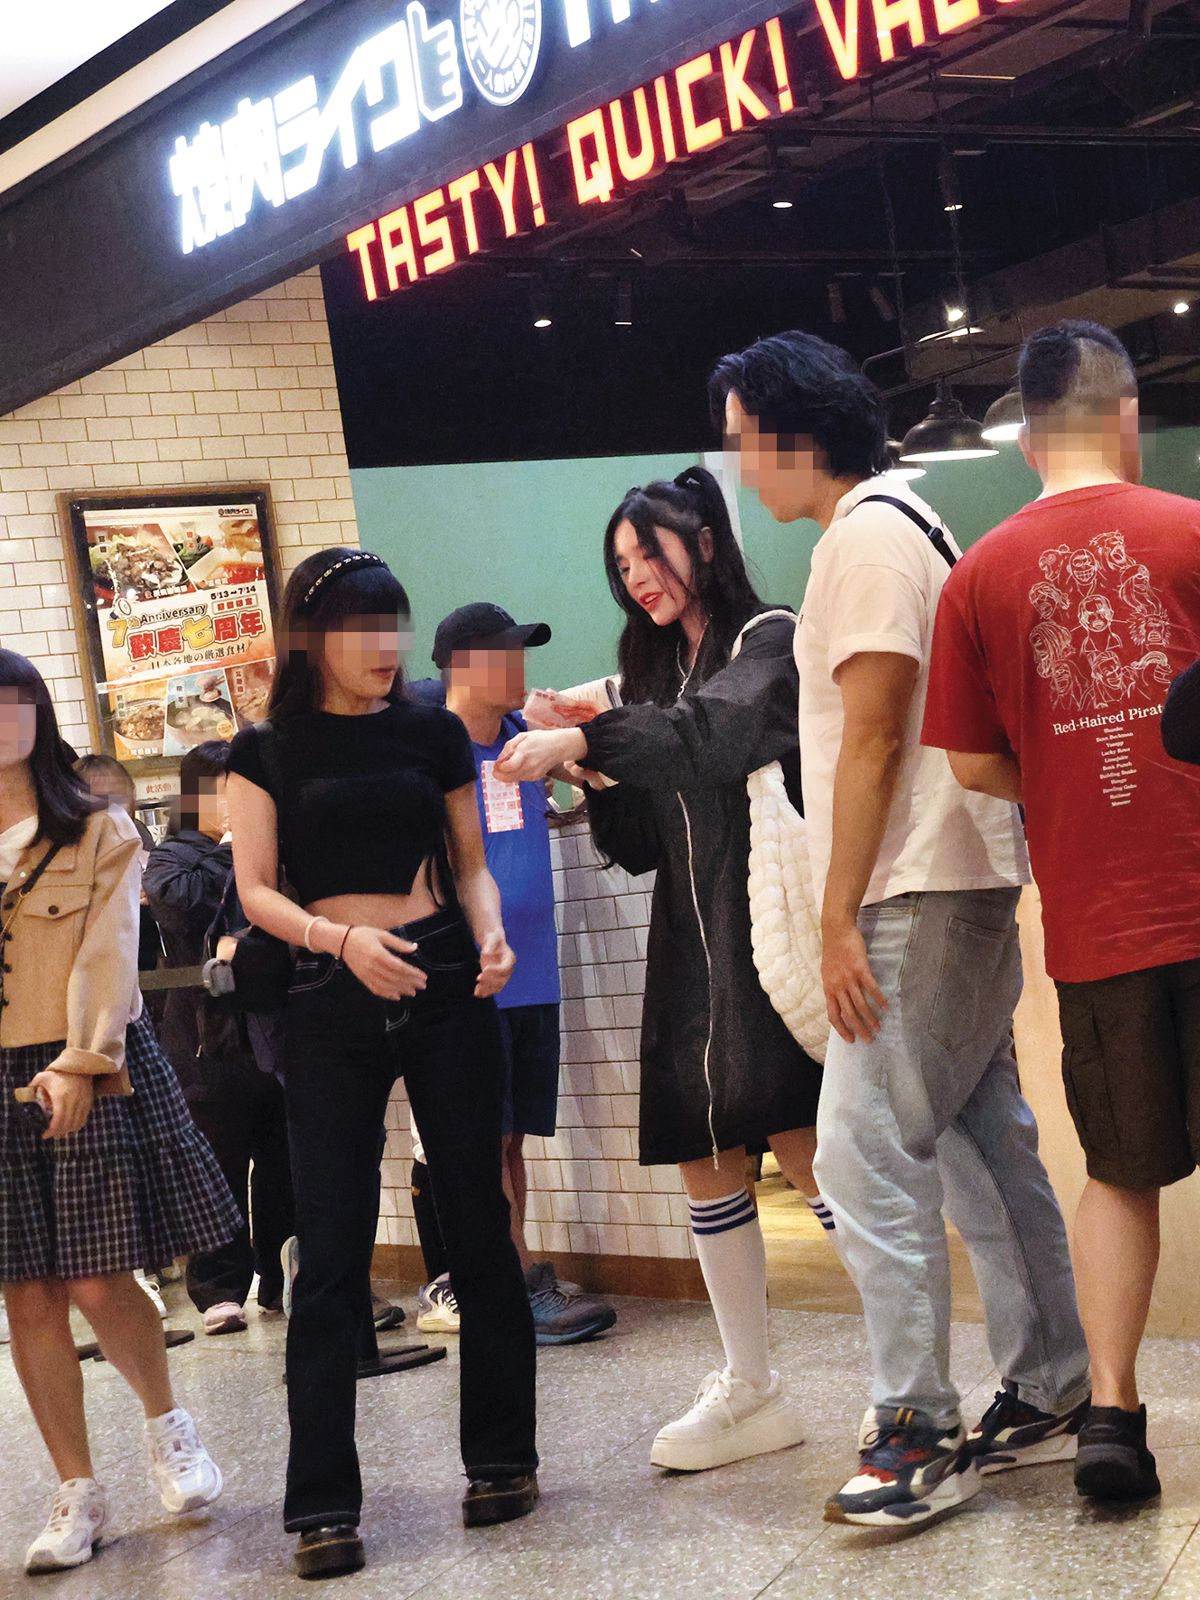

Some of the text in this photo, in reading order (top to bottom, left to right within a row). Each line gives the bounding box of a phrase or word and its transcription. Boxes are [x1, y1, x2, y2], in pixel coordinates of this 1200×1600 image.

[346, 142, 546, 303] TASTY!
[566, 16, 798, 206] QUICK!
[813, 0, 1020, 81] VA
[140, 603, 208, 624] Anniversary
[1052, 703, 1164, 736] Red-Haired Pirat
